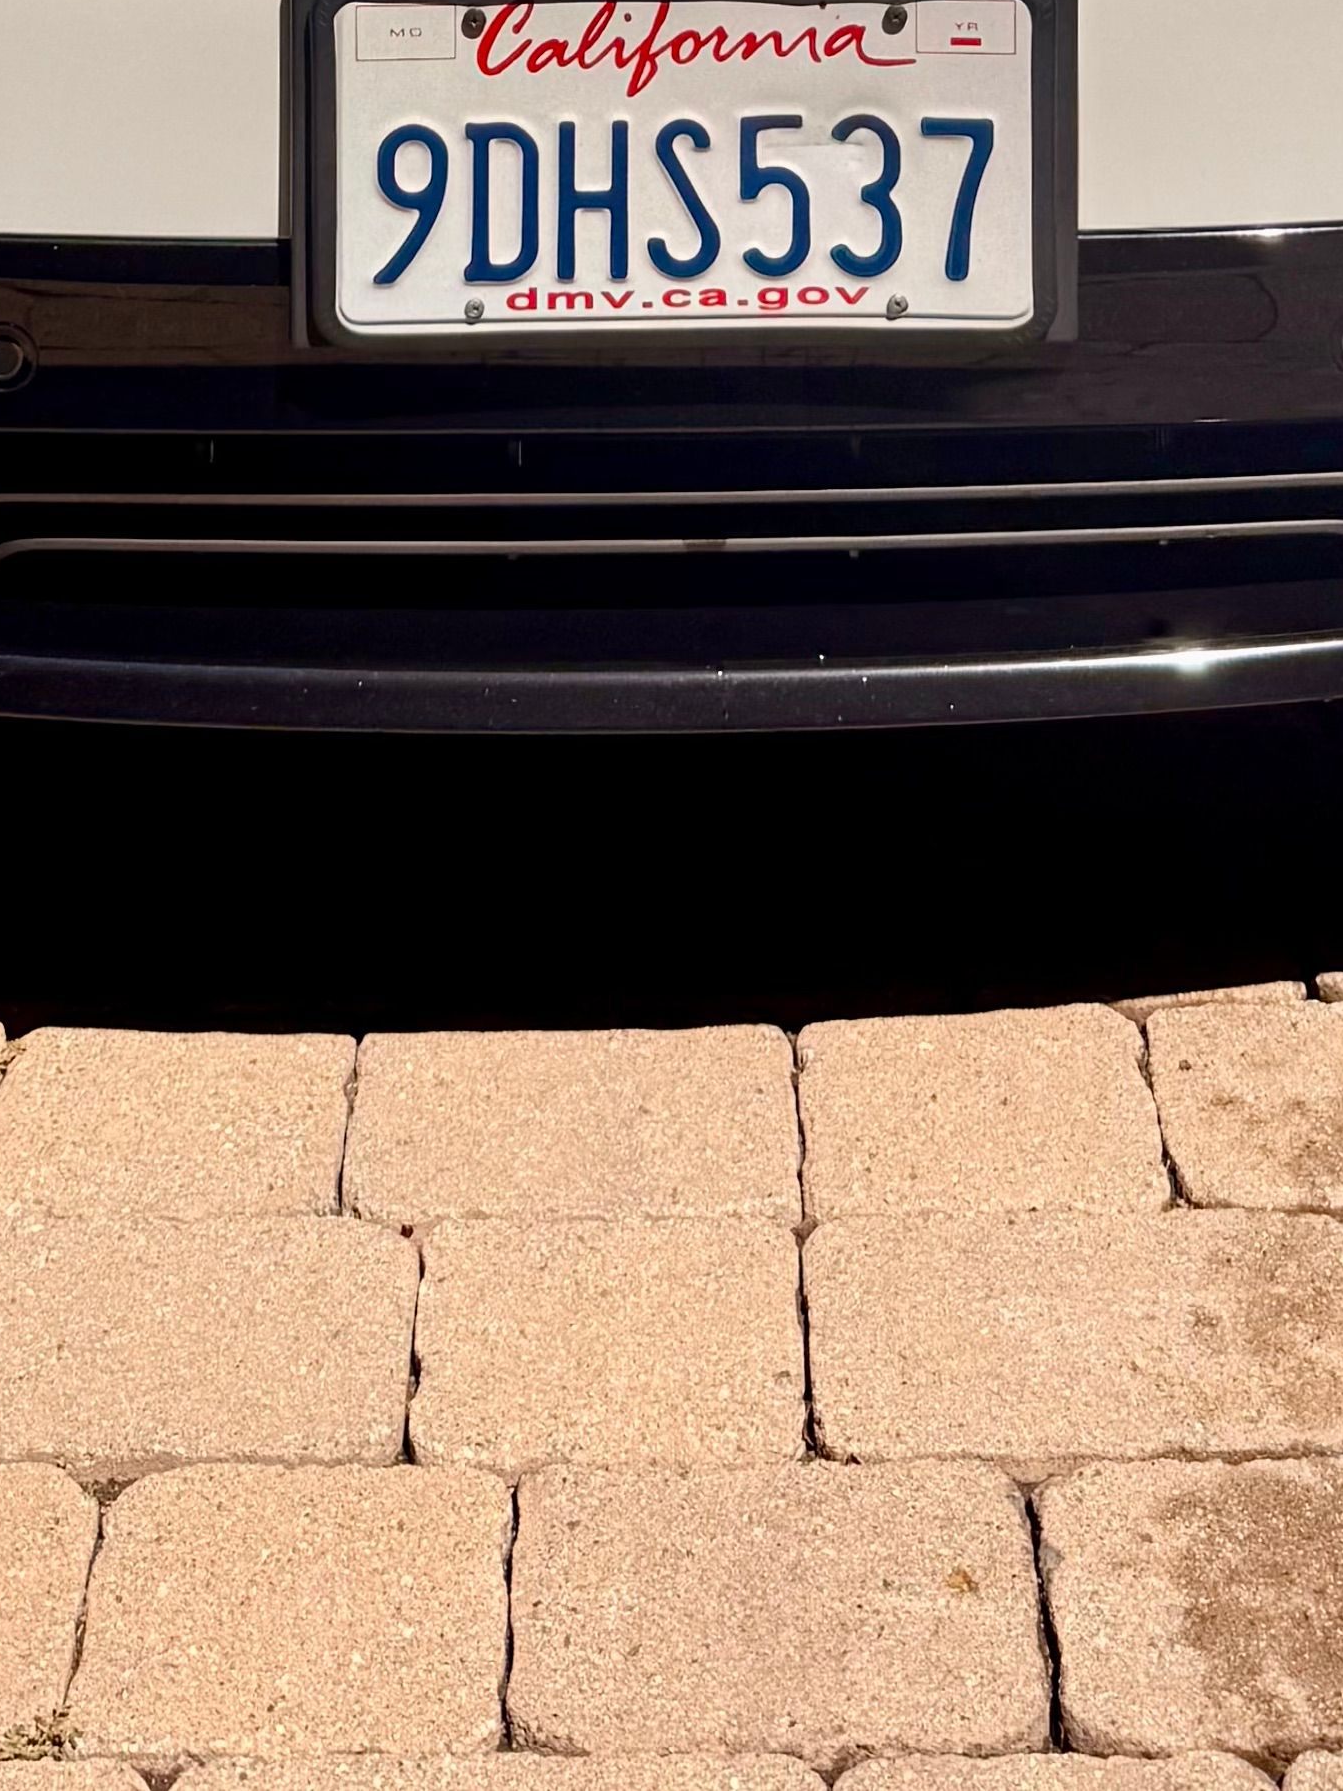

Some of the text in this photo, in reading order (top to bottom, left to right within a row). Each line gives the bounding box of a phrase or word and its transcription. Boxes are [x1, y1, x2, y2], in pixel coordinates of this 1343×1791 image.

[390, 27, 422, 37] MO
[954, 22, 978, 31] YR
[373, 114, 995, 285] 9DHS537
[506, 286, 870, 312] dmv.ca.gov
